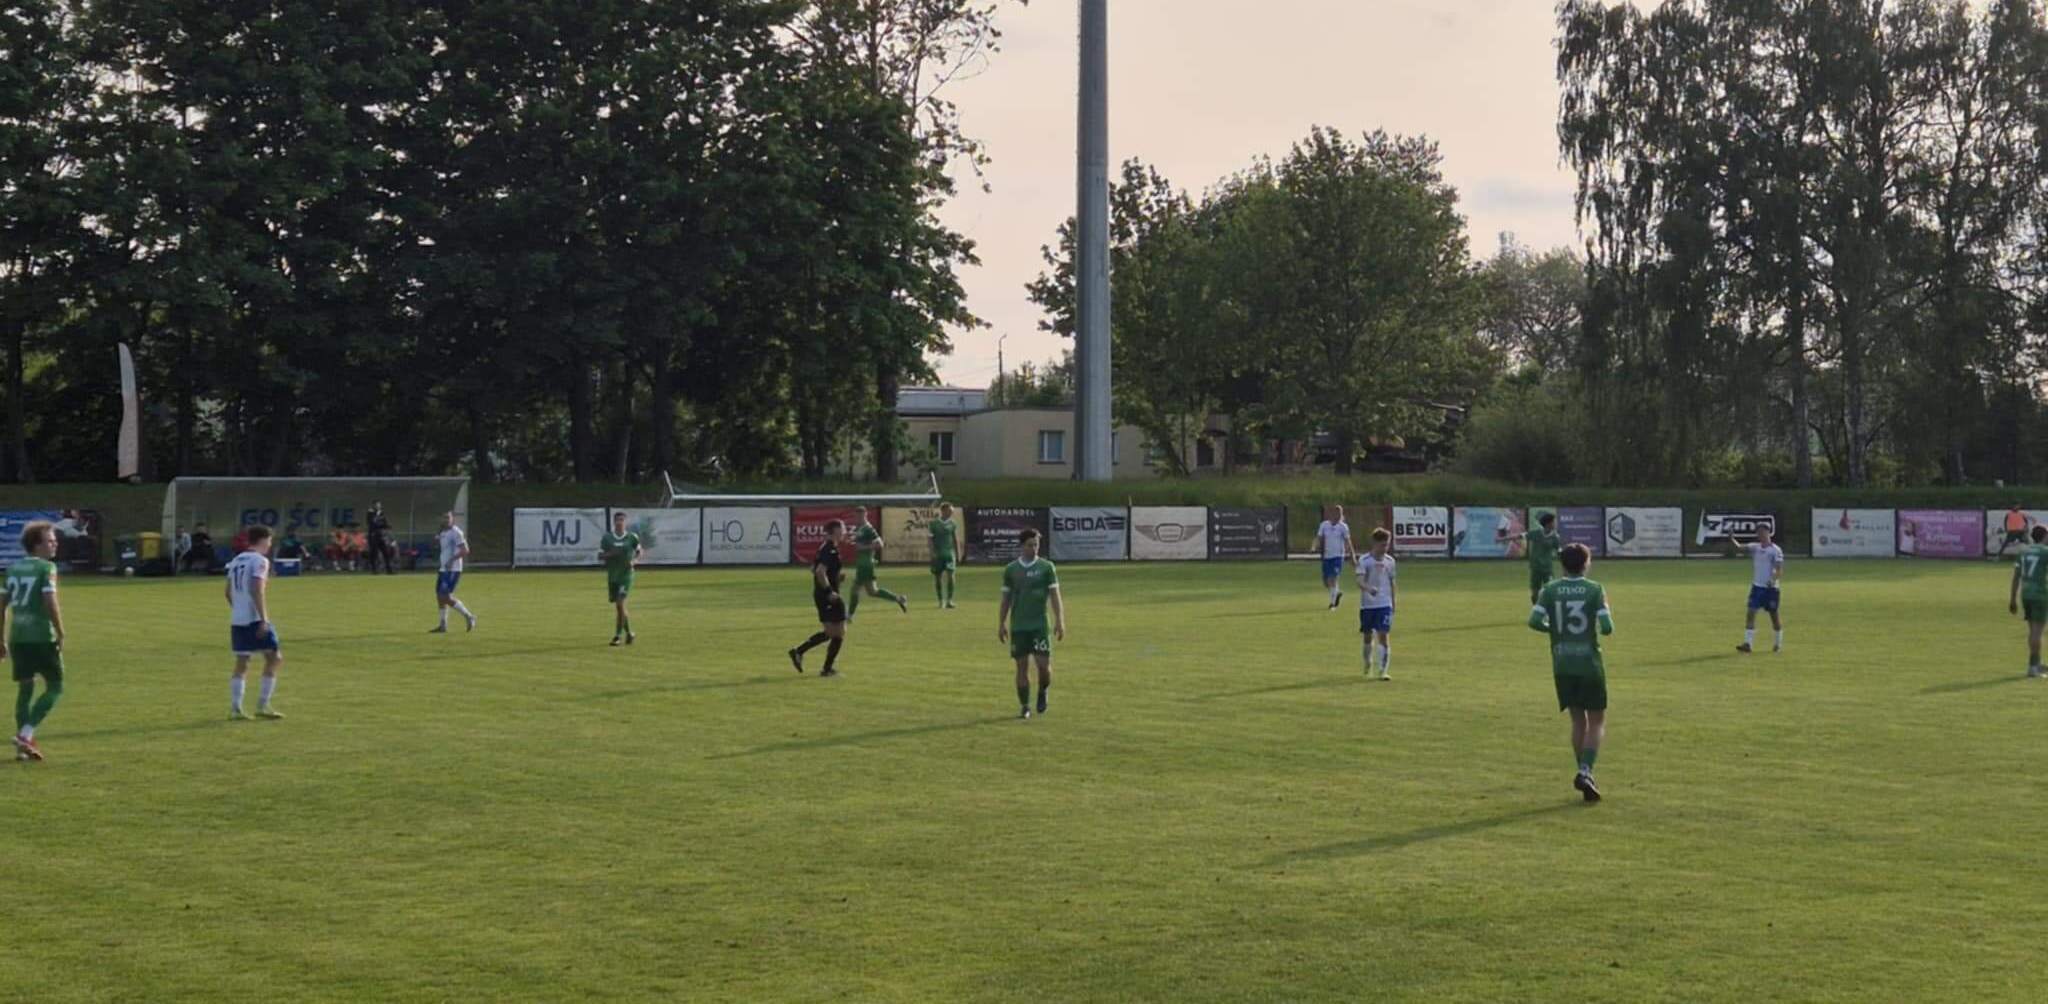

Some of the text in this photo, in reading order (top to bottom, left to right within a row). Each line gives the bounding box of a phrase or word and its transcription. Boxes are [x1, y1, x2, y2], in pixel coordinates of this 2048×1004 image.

[542, 519, 582, 546] MJ
[1053, 517, 1106, 532] EGIDA
[1395, 523, 1446, 536] BETON
[7, 575, 37, 607] 27
[1554, 600, 1588, 635] 13
